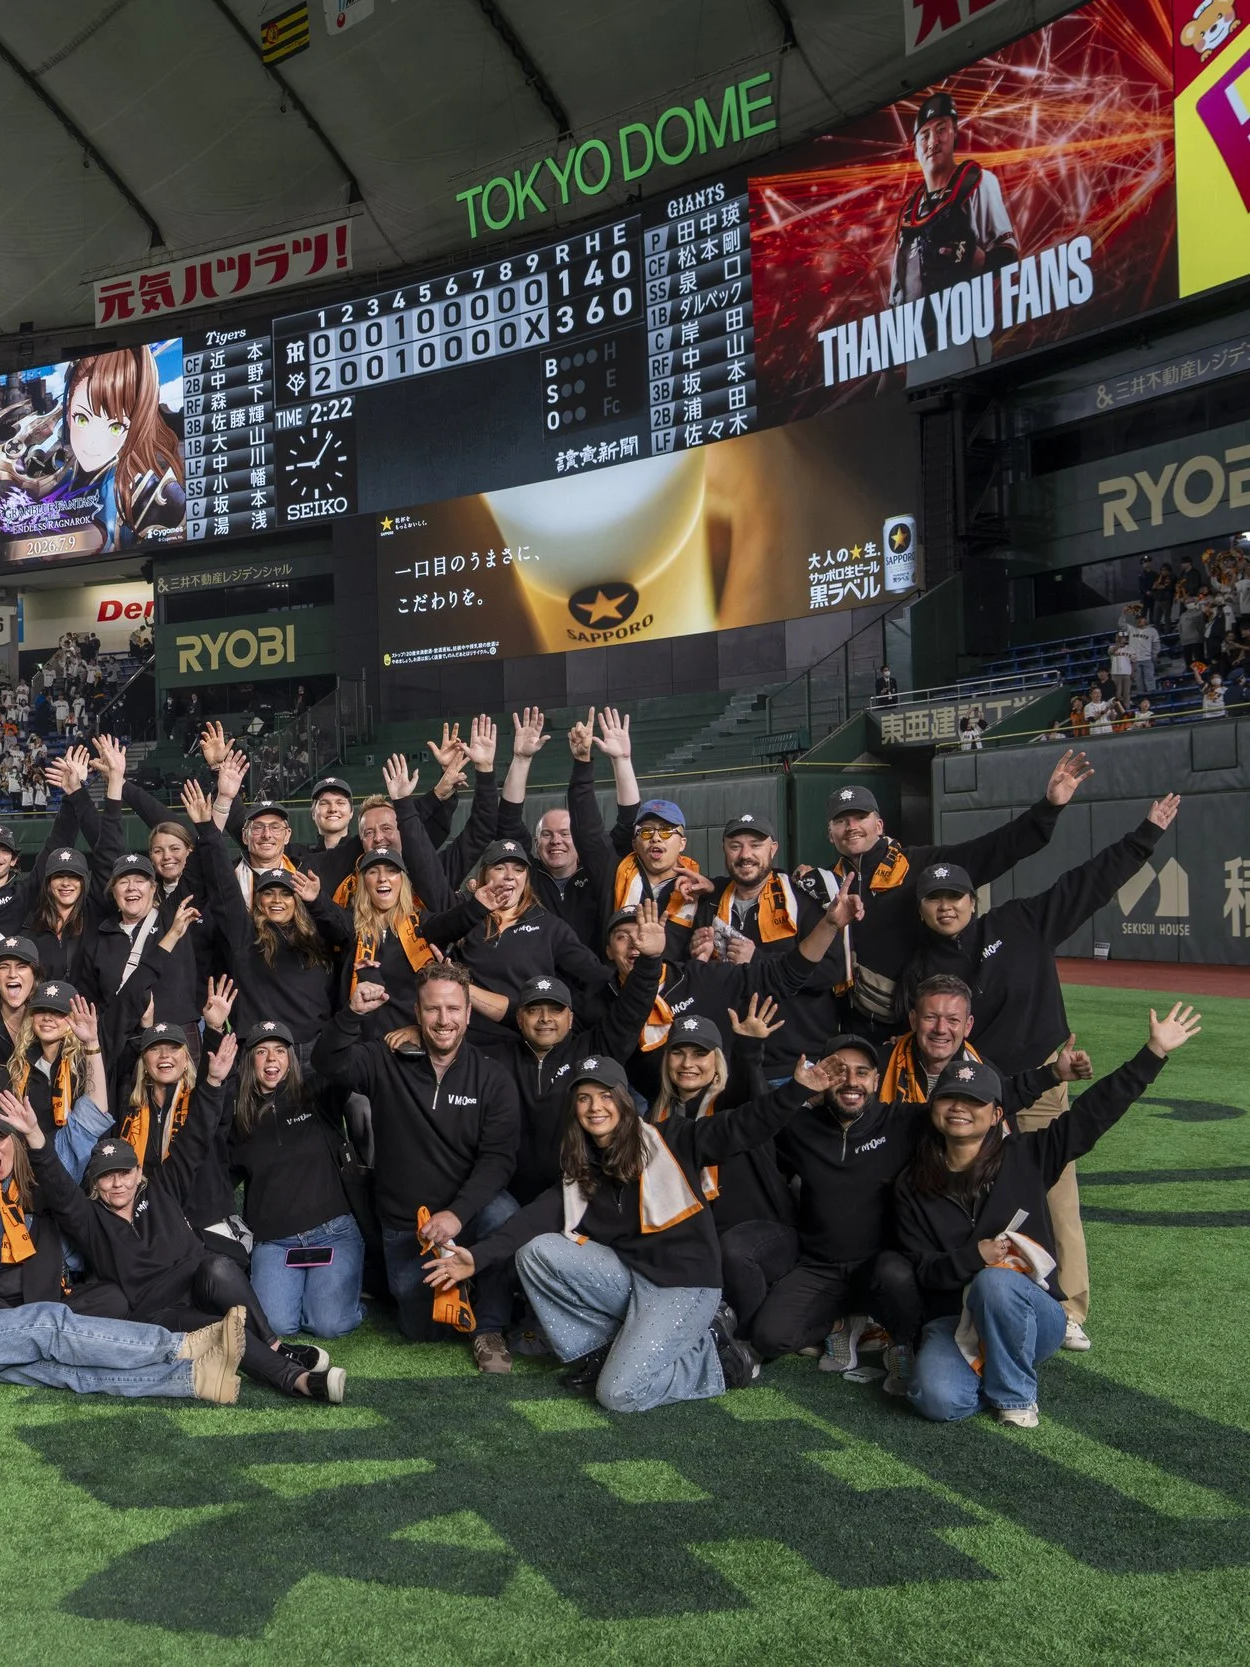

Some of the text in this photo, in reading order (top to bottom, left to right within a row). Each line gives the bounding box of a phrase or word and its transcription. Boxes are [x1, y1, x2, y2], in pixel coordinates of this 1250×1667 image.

[456, 72, 777, 239] TOKYO DOME
[667, 183, 725, 218] GIANTS
[652, 203, 740, 251] P 田中瑛
[649, 228, 741, 277] CF 松本剛
[318, 223, 627, 328] 1 2 3 4 5 6 7 8 9 R H E
[650, 282, 666, 301] SS
[313, 250, 631, 359] 0 0 0 1 0 0 0 0 0 1 4 0
[651, 281, 742, 326] 1B ダルベック
[818, 235, 1093, 387] THANK YOU FANS
[206, 329, 246, 345] Tigers
[314, 287, 632, 392] 2 0 0 1 0 0 0 0 X 3 6 0
[655, 333, 664, 350] C
[185, 357, 200, 374] CF
[546, 358, 558, 378] B
[652, 357, 669, 377] RF
[186, 379, 200, 394] 2B
[547, 385, 559, 404] S
[653, 382, 670, 402] 3B
[187, 398, 200, 415] RF
[275, 397, 353, 429] TIME 2:22
[187, 404, 265, 435] 3B 佐藤輝
[547, 411, 560, 430] O
[654, 408, 670, 427] 2B
[656, 412, 748, 452] LF 佐々木
[188, 440, 202, 456] 1B
[188, 459, 202, 476] LF
[188, 480, 203, 497] SS
[192, 502, 199, 517] C
[287, 497, 348, 521] SEIKO
[13, 521, 47, 534] ENDLESS
[48, 515, 91, 531] RAGNAROK
[153, 526, 183, 537] Cygames
[193, 524, 200, 537] P
[26, 536, 76, 556] 2026.7.9
[395, 546, 540, 579] 一口目のうまさに、
[885, 552, 916, 566] SAPPORO
[170, 563, 294, 590] 三井不動産レジデンシャル
[809, 561, 880, 586] サッポロ生ビール
[398, 588, 483, 614] こだわりを。
[809, 576, 881, 609] 黒ラベル
[567, 613, 655, 644] SAPPORO
[176, 624, 295, 673] RYOBI
[1122, 922, 1190, 936] SEKISUI HOUSE
